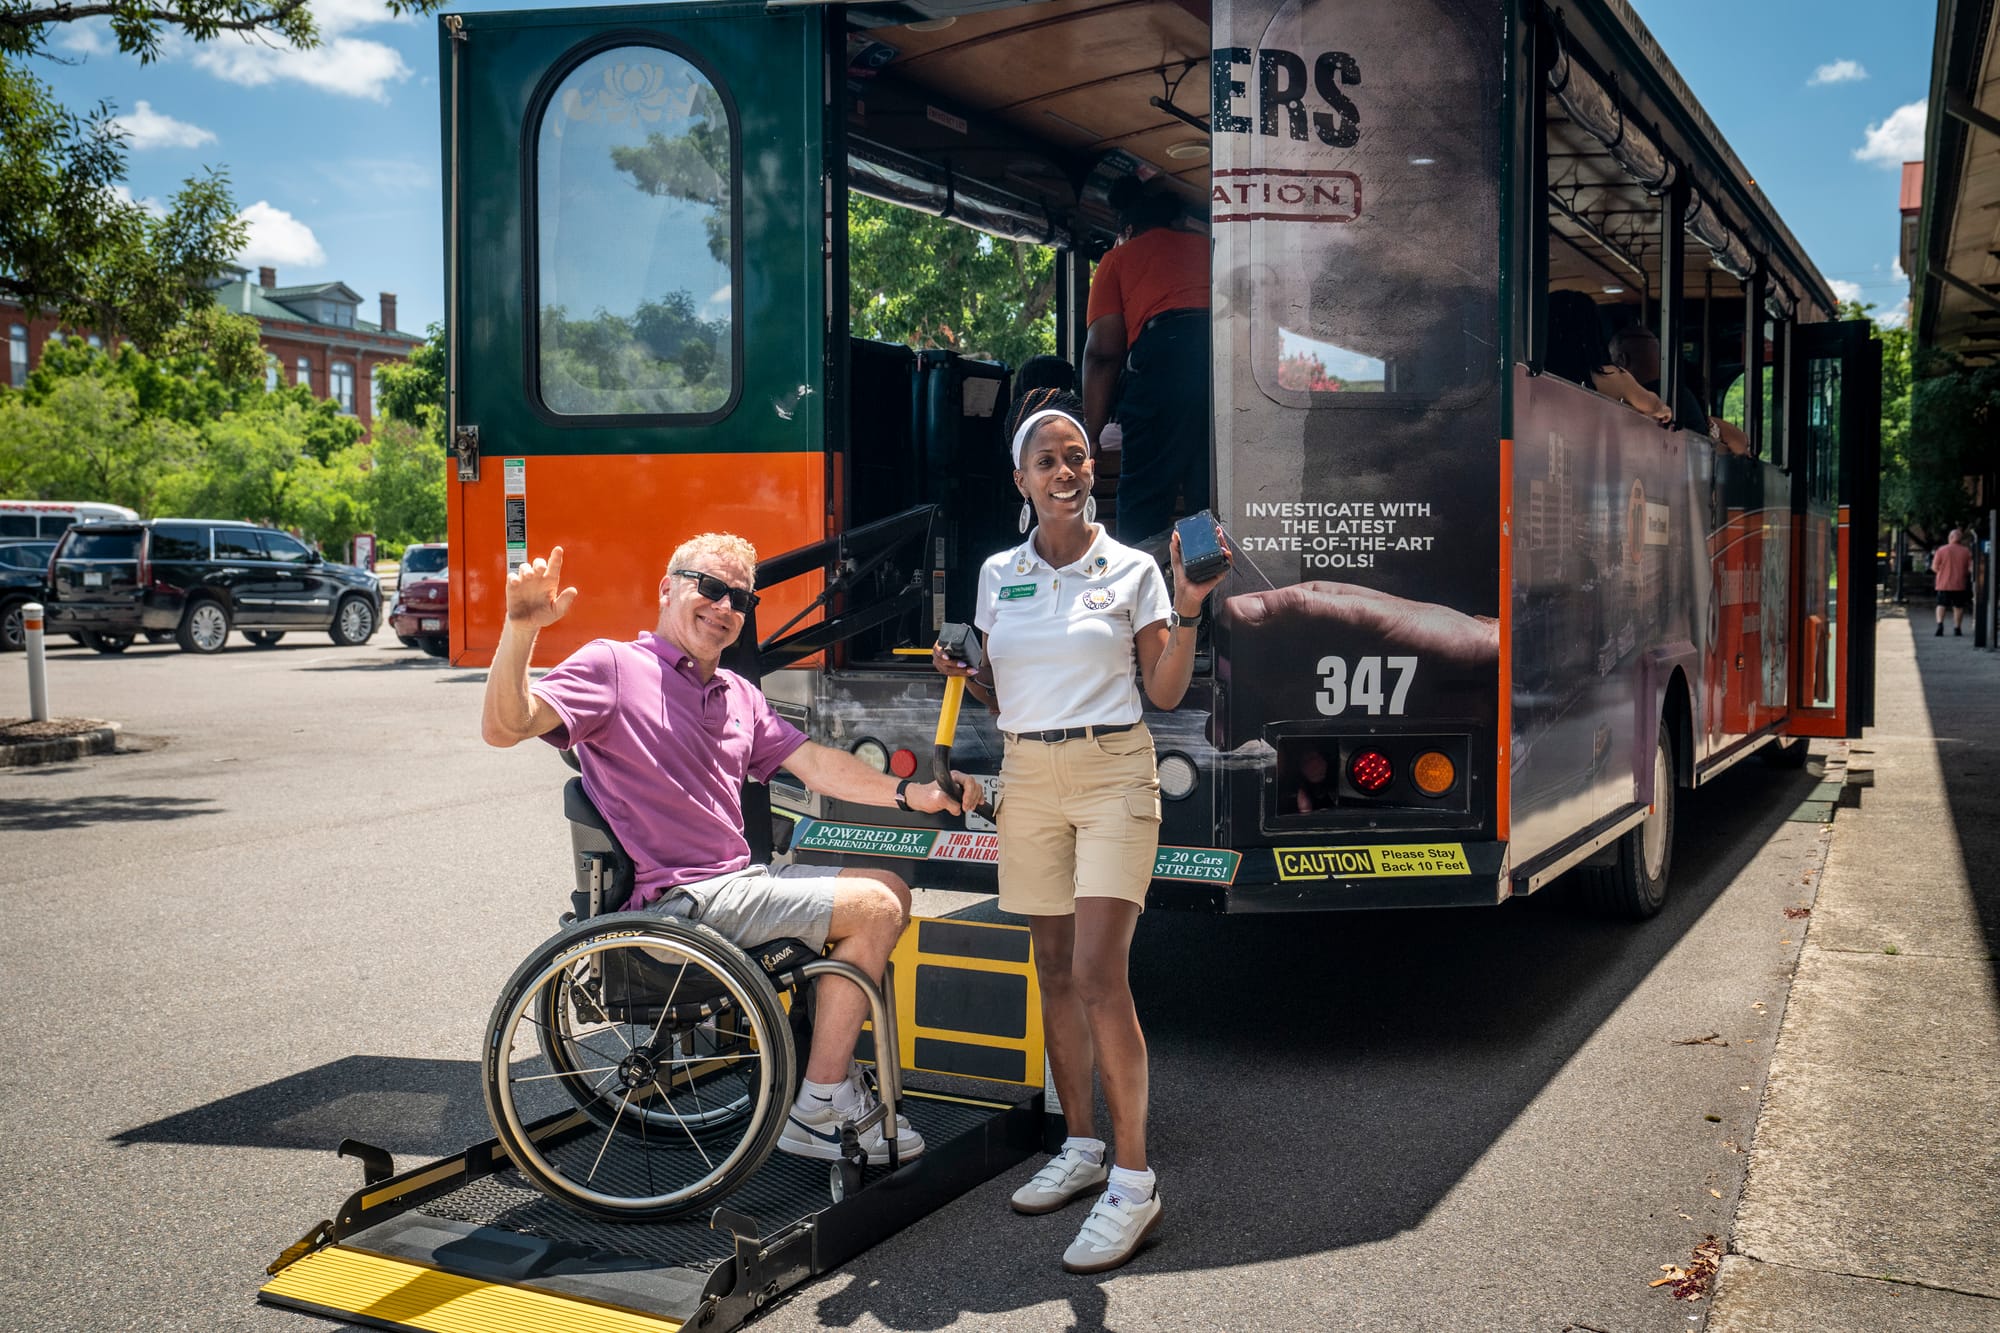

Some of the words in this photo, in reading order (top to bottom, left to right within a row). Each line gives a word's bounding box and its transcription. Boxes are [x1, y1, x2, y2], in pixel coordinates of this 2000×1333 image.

[1213, 47, 1361, 148] ERS
[1213, 184, 1339, 205] ATION
[1245, 503, 1375, 517] INVESTIGATE
[1379, 503, 1431, 517] WITH
[1281, 520, 1320, 534] THE
[1325, 520, 1397, 534] LATEST
[1242, 537, 1435, 551] STATE-OF-THE-ART
[1303, 554, 1374, 568] TOOLS!
[1315, 655, 1418, 716] 347
[817, 825, 897, 843] POWERED
[899, 832, 924, 845] BY
[948, 833, 973, 846] THIS
[803, 836, 879, 850] ECO-FRIENDLY
[879, 843, 928, 854] PROPANE
[935, 845, 955, 858] ALL
[1170, 851, 1189, 863] 20
[1192, 852, 1223, 865] Cars
[1381, 849, 1425, 859] Please
[1427, 848, 1455, 860] Stay
[1283, 852, 1371, 874] CAUTION
[1381, 862, 1415, 873] Back
[1419, 861, 1433, 872] 10
[1436, 860, 1465, 871] Feet
[1154, 863, 1228, 878] STREETS!
[771, 946, 794, 965] JAVA
